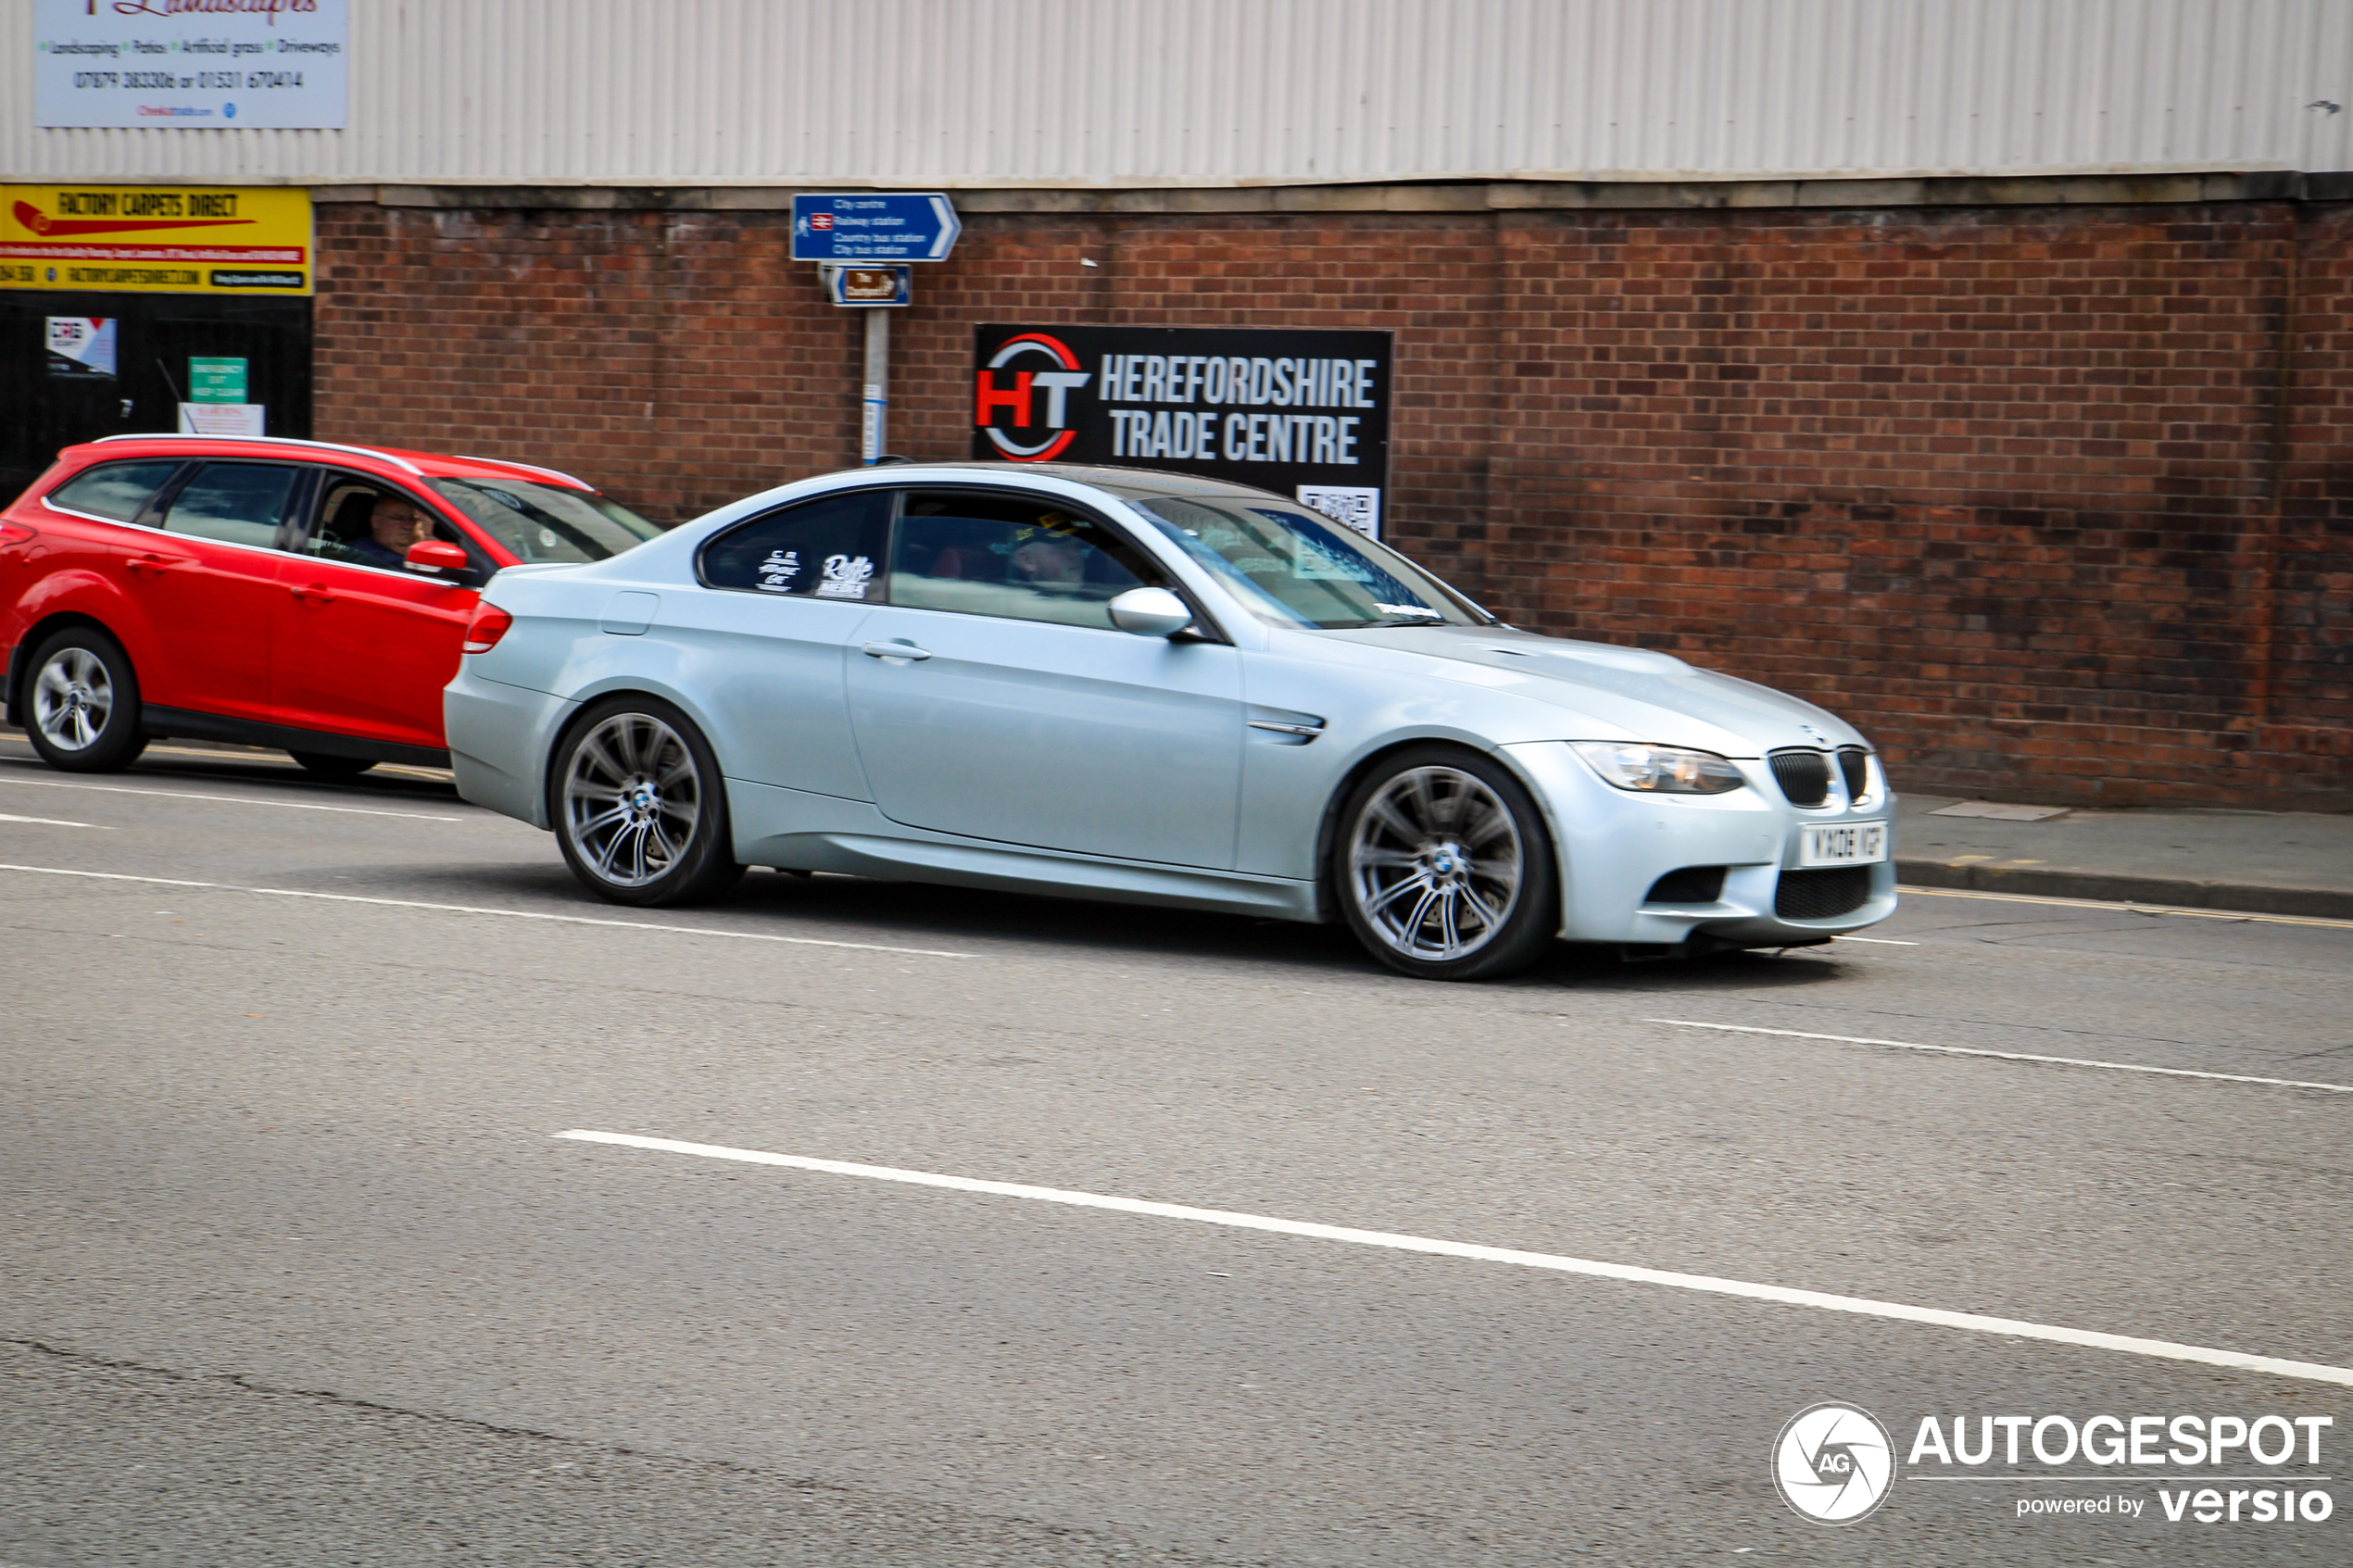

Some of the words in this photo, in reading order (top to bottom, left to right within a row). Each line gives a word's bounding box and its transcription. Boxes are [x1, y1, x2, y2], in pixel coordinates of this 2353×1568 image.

[49, 38, 120, 58] Landscaping
[132, 39, 168, 54] Patios
[181, 37, 229, 54] Artificial
[233, 43, 265, 57] grass
[277, 38, 342, 57] Driveways
[180, 77, 195, 88] or
[57, 193, 118, 216] FACTORY
[122, 194, 182, 217] CARPETS
[188, 194, 238, 218] DIRECT
[833, 199, 854, 210] City
[854, 201, 887, 209] centre
[834, 217, 870, 227] Railway
[871, 218, 906, 226] station
[833, 232, 871, 244] Country
[872, 233, 889, 243] bus
[890, 232, 926, 243] station
[833, 245, 853, 256] City
[854, 245, 874, 255] bus
[874, 245, 908, 255] station
[1099, 354, 1378, 408] HEREFORDSHIRE
[975, 370, 1092, 430] HT
[1109, 409, 1217, 460] TRADE
[1223, 413, 1361, 465] CENTRE
